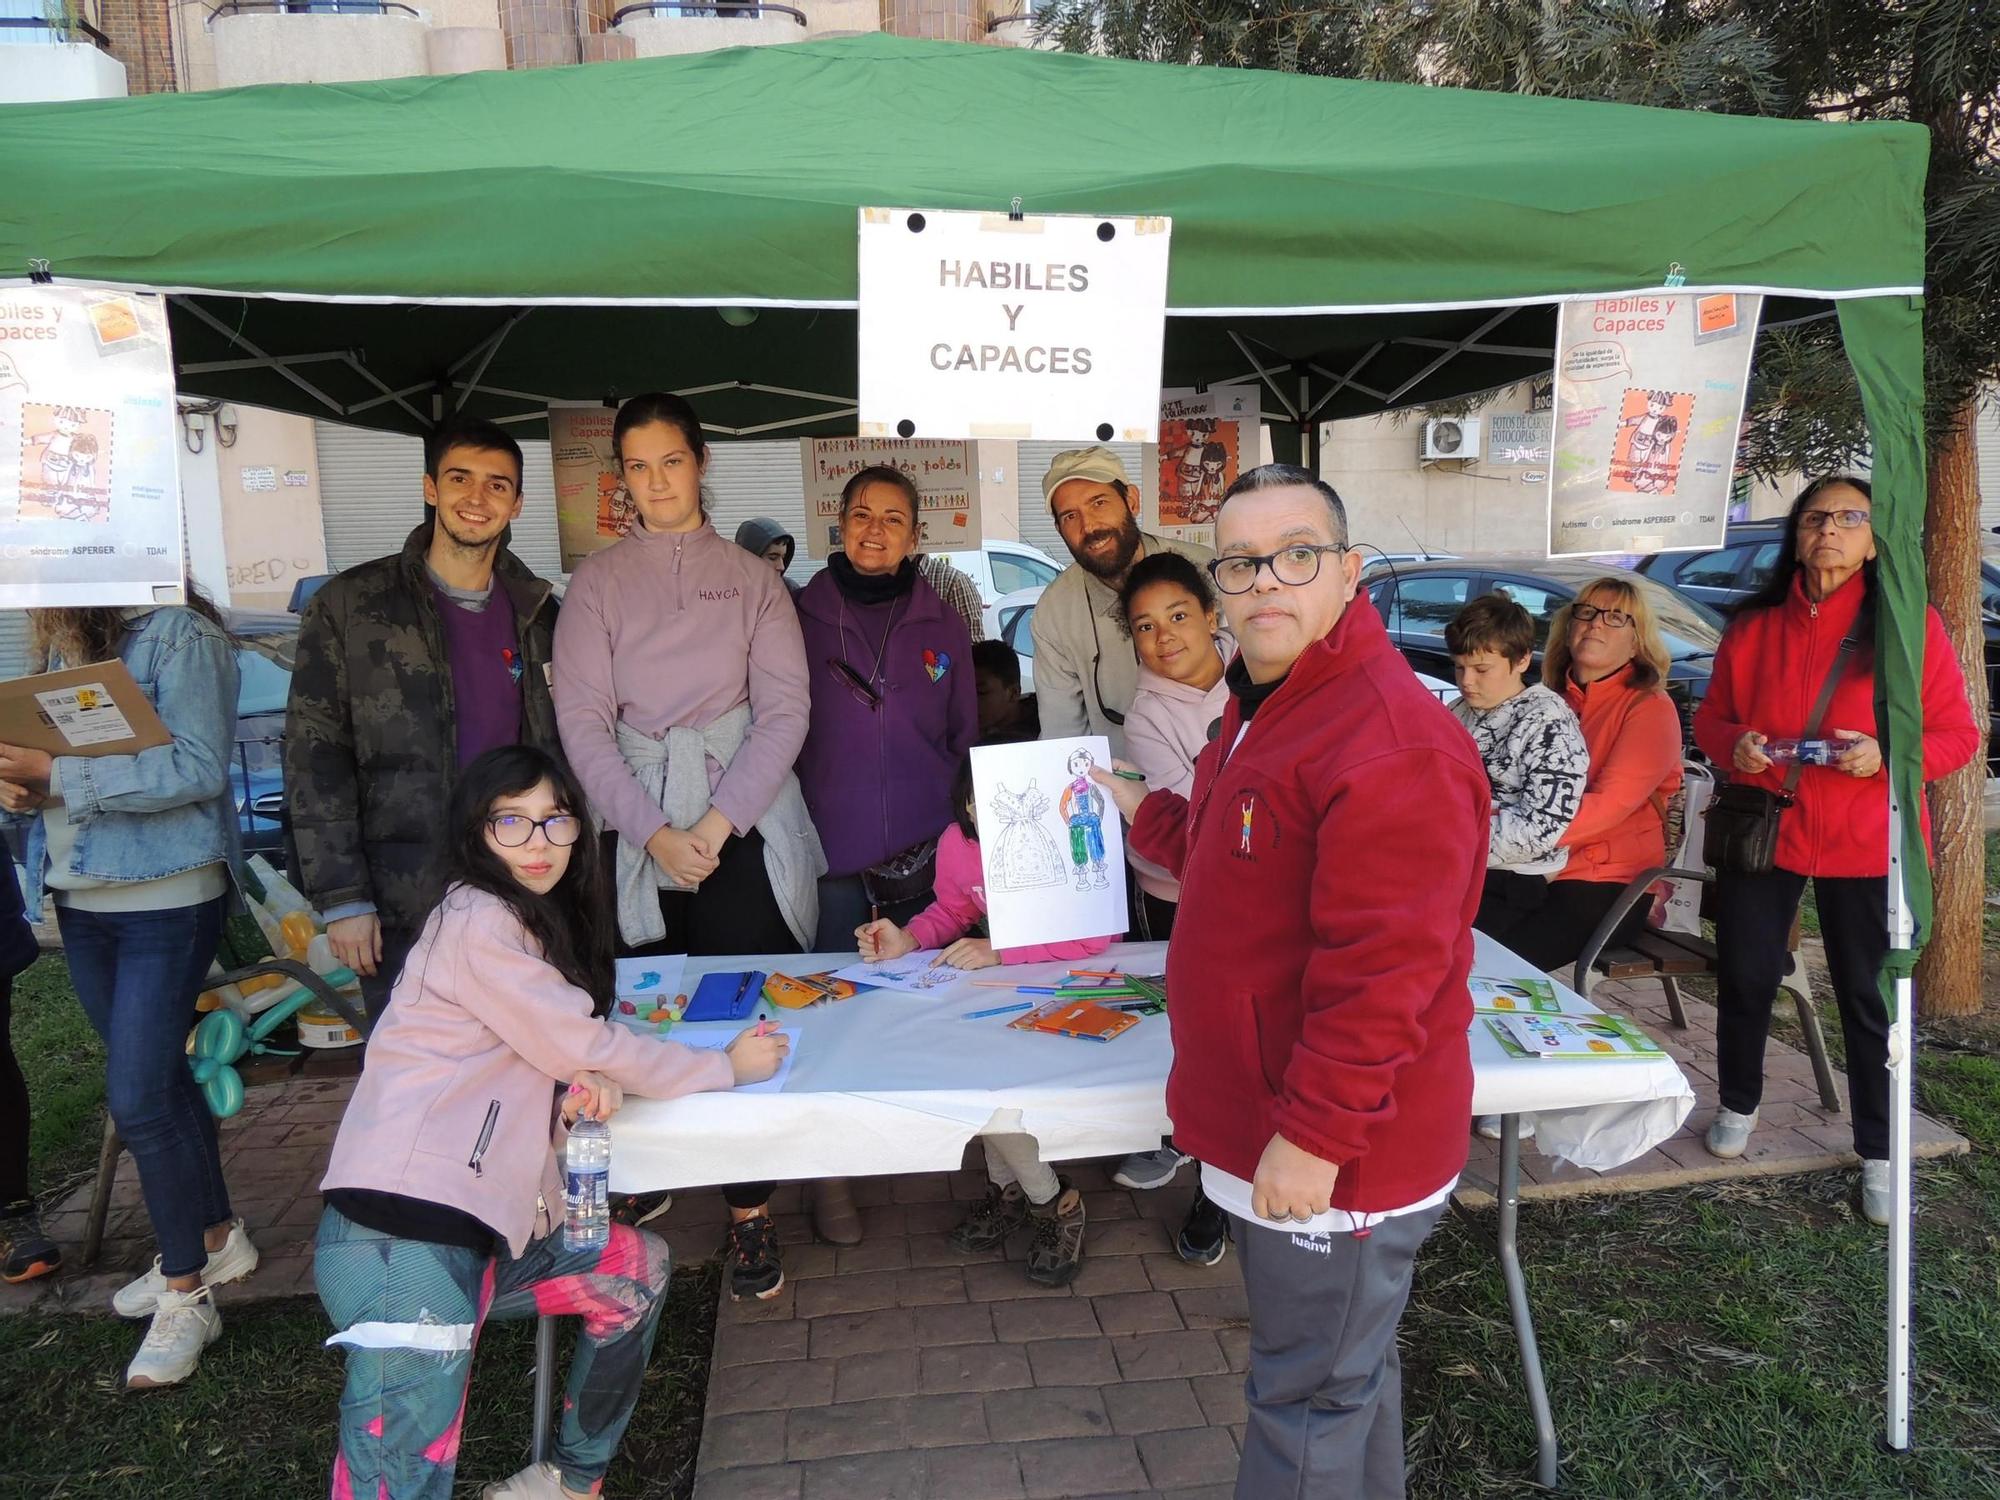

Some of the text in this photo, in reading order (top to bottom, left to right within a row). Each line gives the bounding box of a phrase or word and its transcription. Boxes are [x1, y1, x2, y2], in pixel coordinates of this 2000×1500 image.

[939, 259, 1089, 292] HABILES
[52, 306, 63, 323] y
[1666, 300, 1676, 315] y
[1001, 304, 1025, 331] Y
[1593, 317, 1665, 335] Capaces
[930, 343, 1092, 375] CAPACES
[1492, 416, 1515, 430] FOTOS
[1516, 415, 1527, 429] DE
[570, 427, 613, 438] Capace
[1492, 429, 1536, 443] FOTOCOPIAS
[1561, 521, 1588, 529] Autismo
[1642, 516, 1676, 524] ASPERGER
[1699, 515, 1716, 523] TDAH
[71, 545, 116, 555] ASPERGER
[146, 547, 168, 556] TDAH
[1291, 1232, 1332, 1254] luanvi
